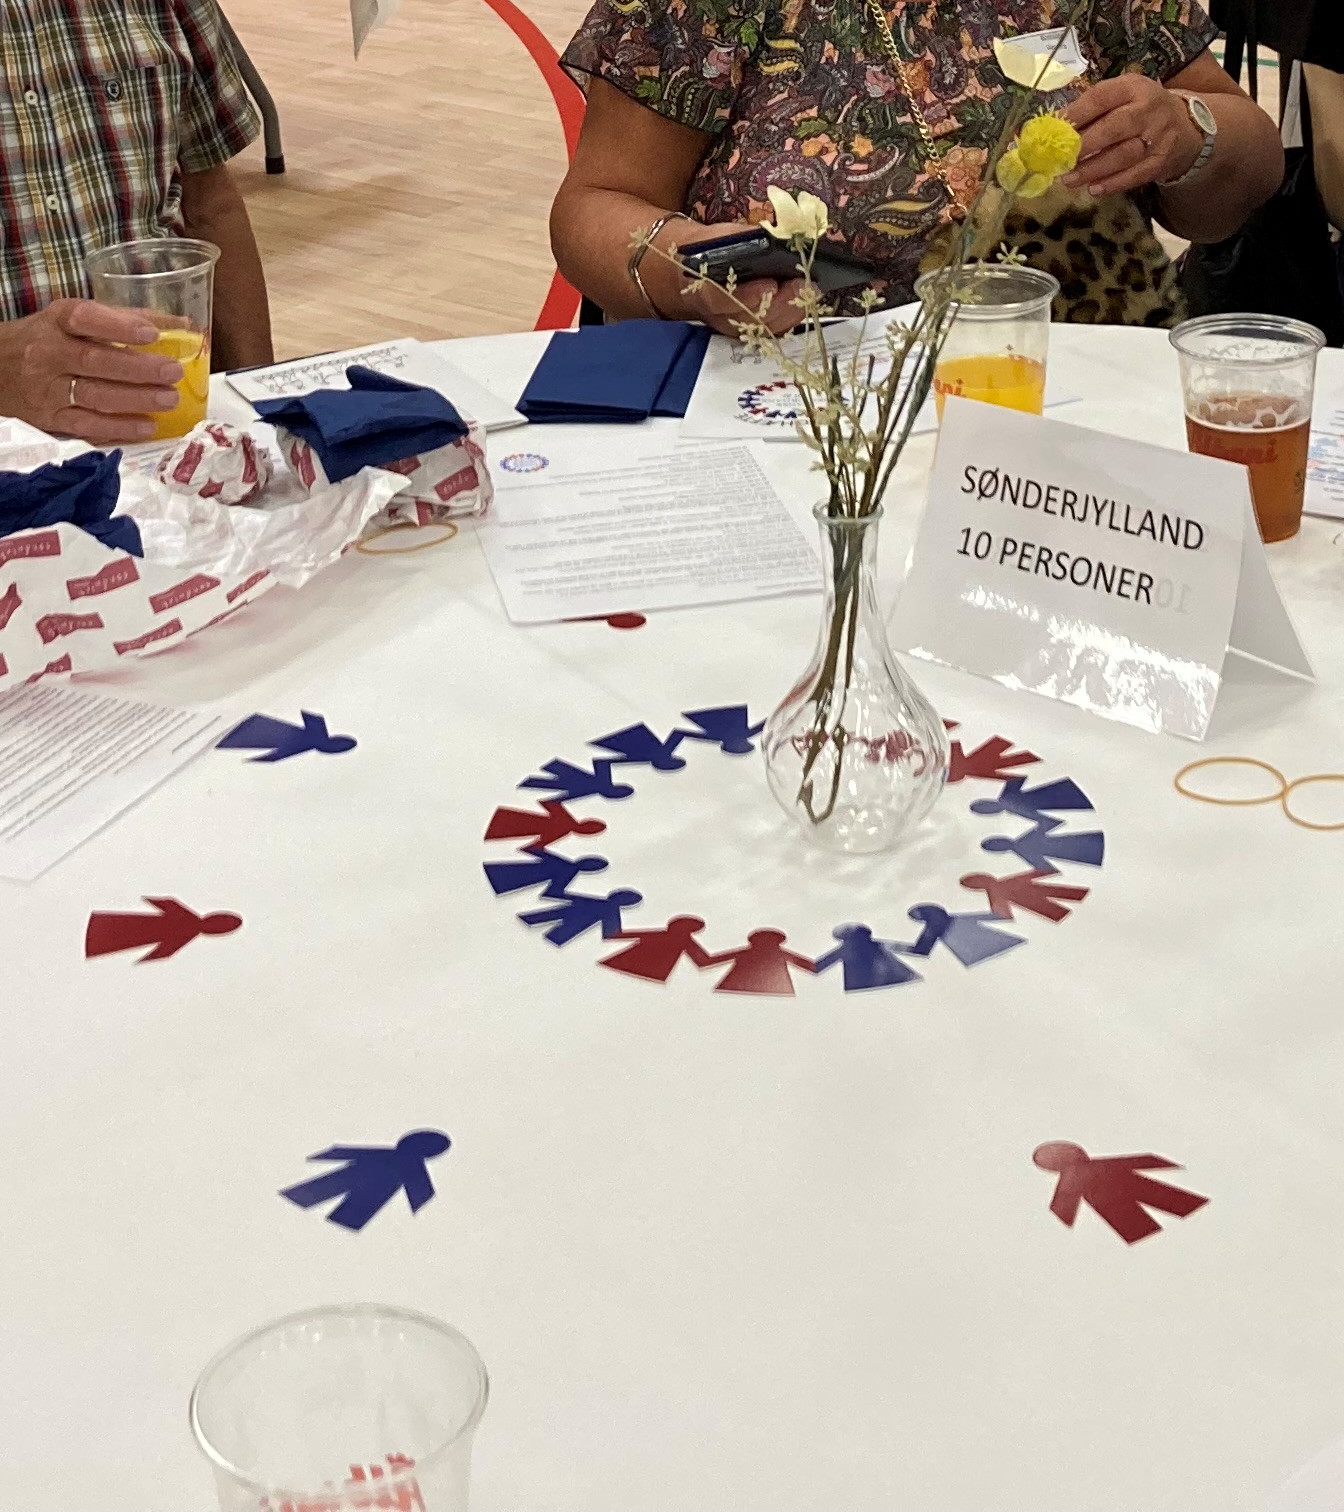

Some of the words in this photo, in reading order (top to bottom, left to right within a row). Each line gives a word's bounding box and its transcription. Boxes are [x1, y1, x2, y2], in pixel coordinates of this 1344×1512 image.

[960, 464, 1205, 551] SØNDERJYLLAND
[956, 527, 992, 560] 10
[998, 537, 1155, 605] PERSONER
